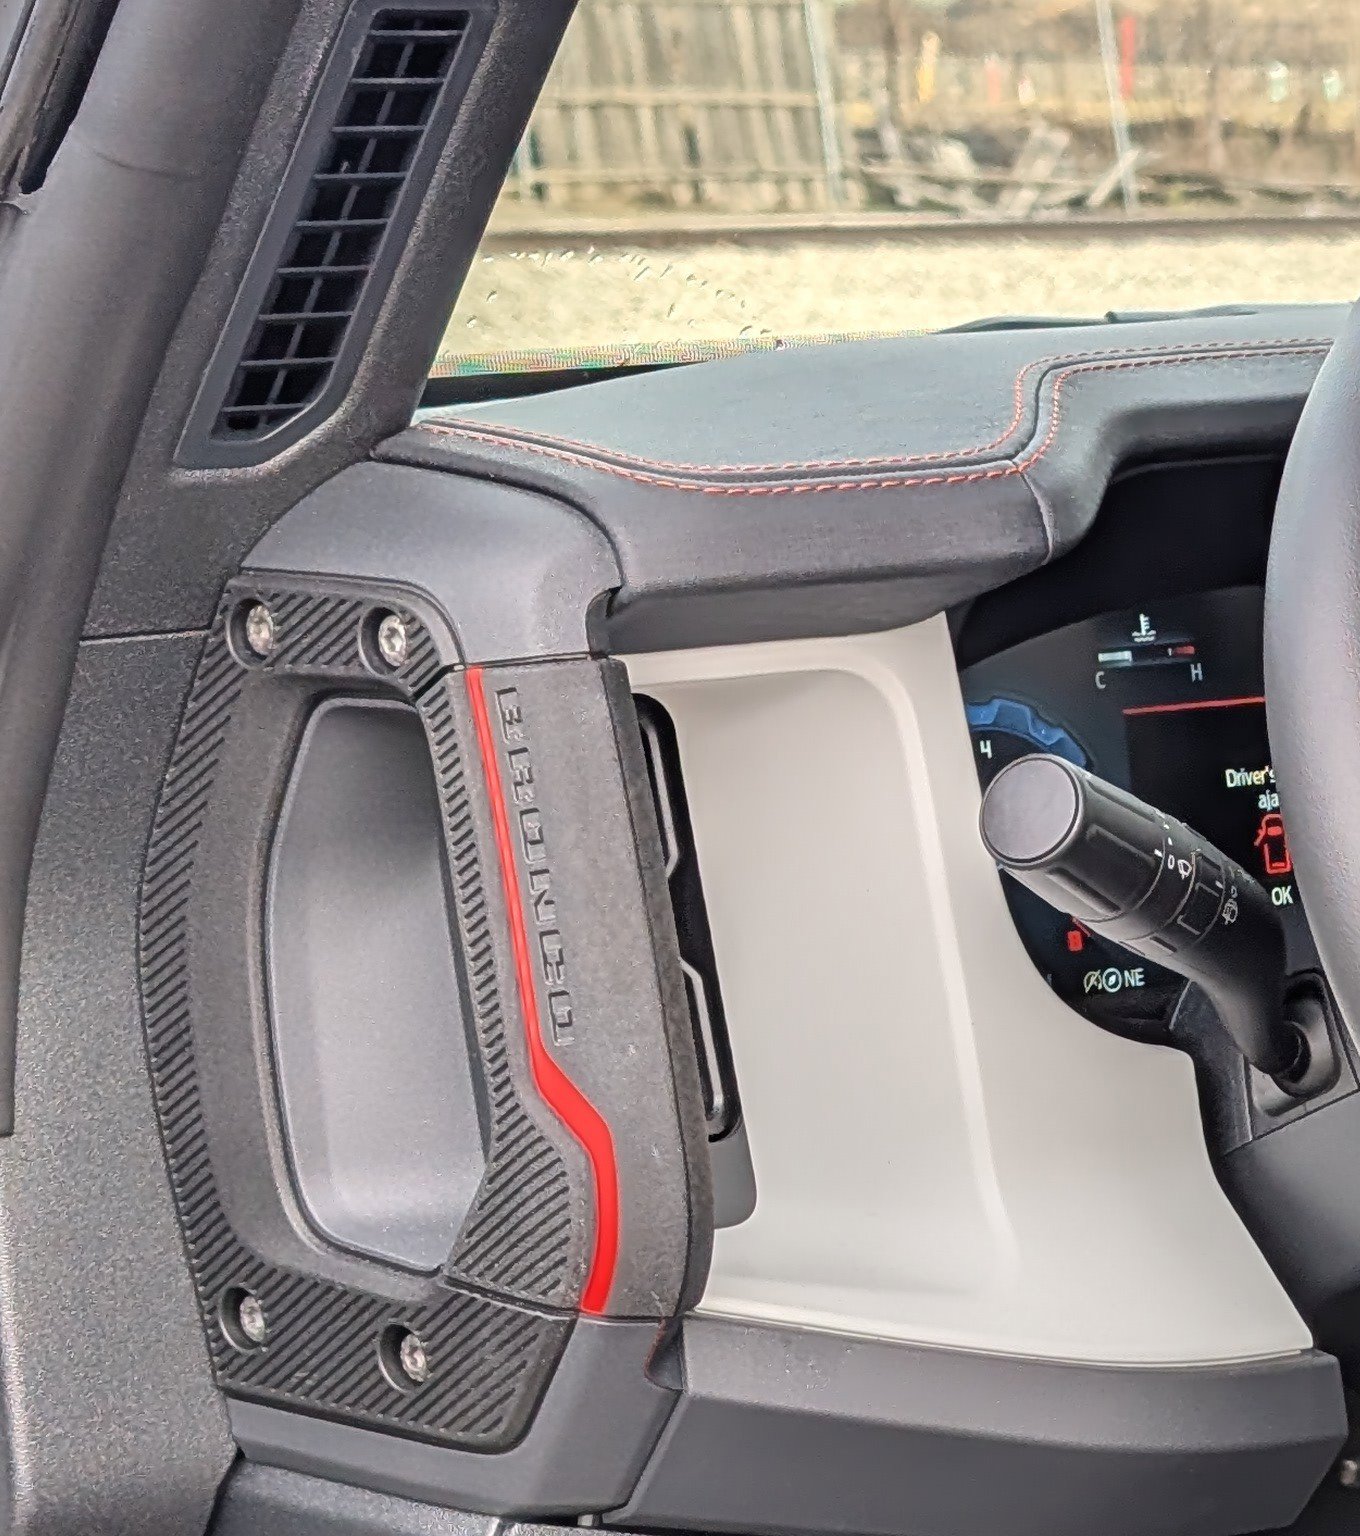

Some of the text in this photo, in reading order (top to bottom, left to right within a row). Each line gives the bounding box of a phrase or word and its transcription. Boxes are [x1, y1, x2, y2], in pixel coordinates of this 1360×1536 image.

[1095, 671, 1107, 690] C
[1190, 663, 1203, 682] H
[495, 686, 575, 1047] BRONCO
[1270, 885, 1295, 906] OK
[1123, 967, 1146, 987] NE
